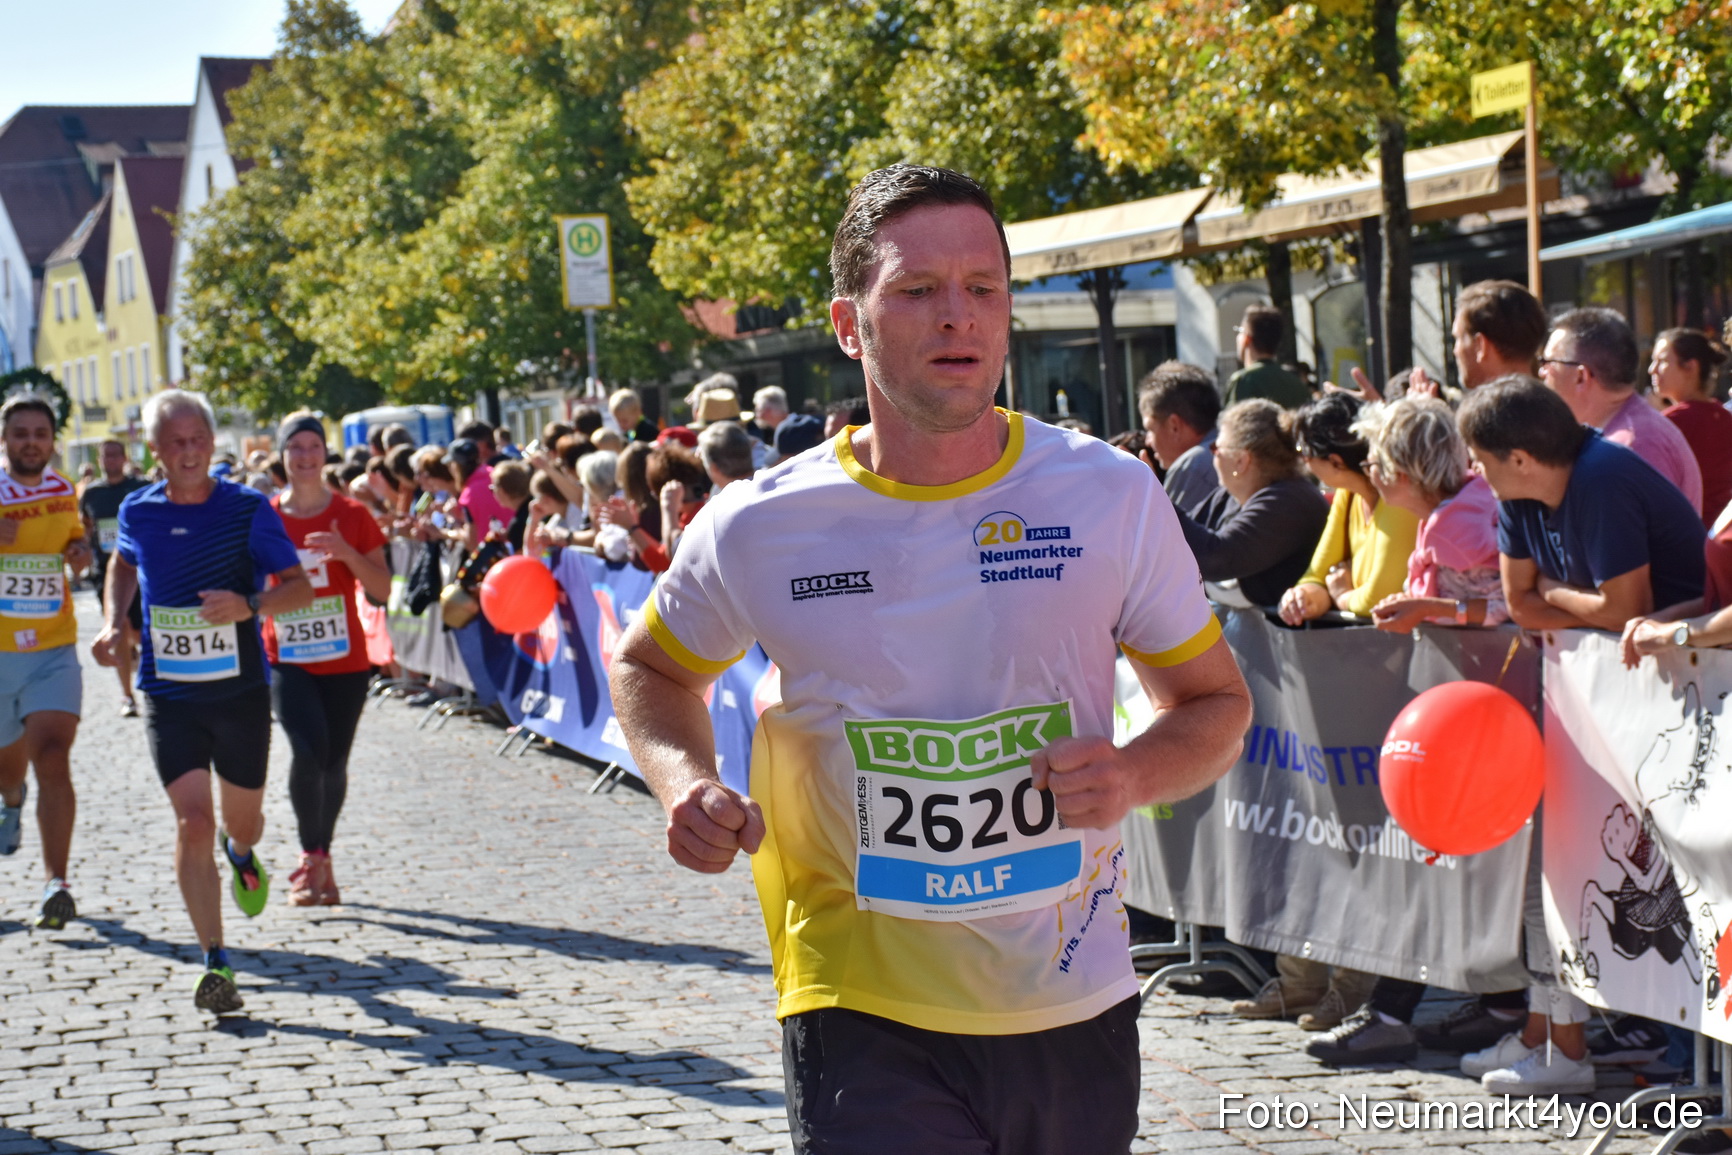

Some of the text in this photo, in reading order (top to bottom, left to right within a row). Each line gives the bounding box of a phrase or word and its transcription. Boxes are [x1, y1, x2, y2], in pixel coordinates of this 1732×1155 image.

[1483, 80, 1525, 101] Toiletten
[980, 519, 1067, 546] 20 JAHRE
[980, 544, 1083, 564] Neumarkter
[791, 571, 873, 595] BOCK
[981, 563, 1064, 583] Stadtlauf
[5, 576, 56, 597] 2375
[793, 592, 815, 601] inspired
[845, 587, 874, 595] concepts
[156, 611, 204, 628] BOC
[284, 618, 337, 642] 2581
[161, 632, 226, 656] 2814
[862, 712, 1053, 773] BOCK
[881, 777, 1055, 853] 2620
[925, 864, 1012, 898] RALF
